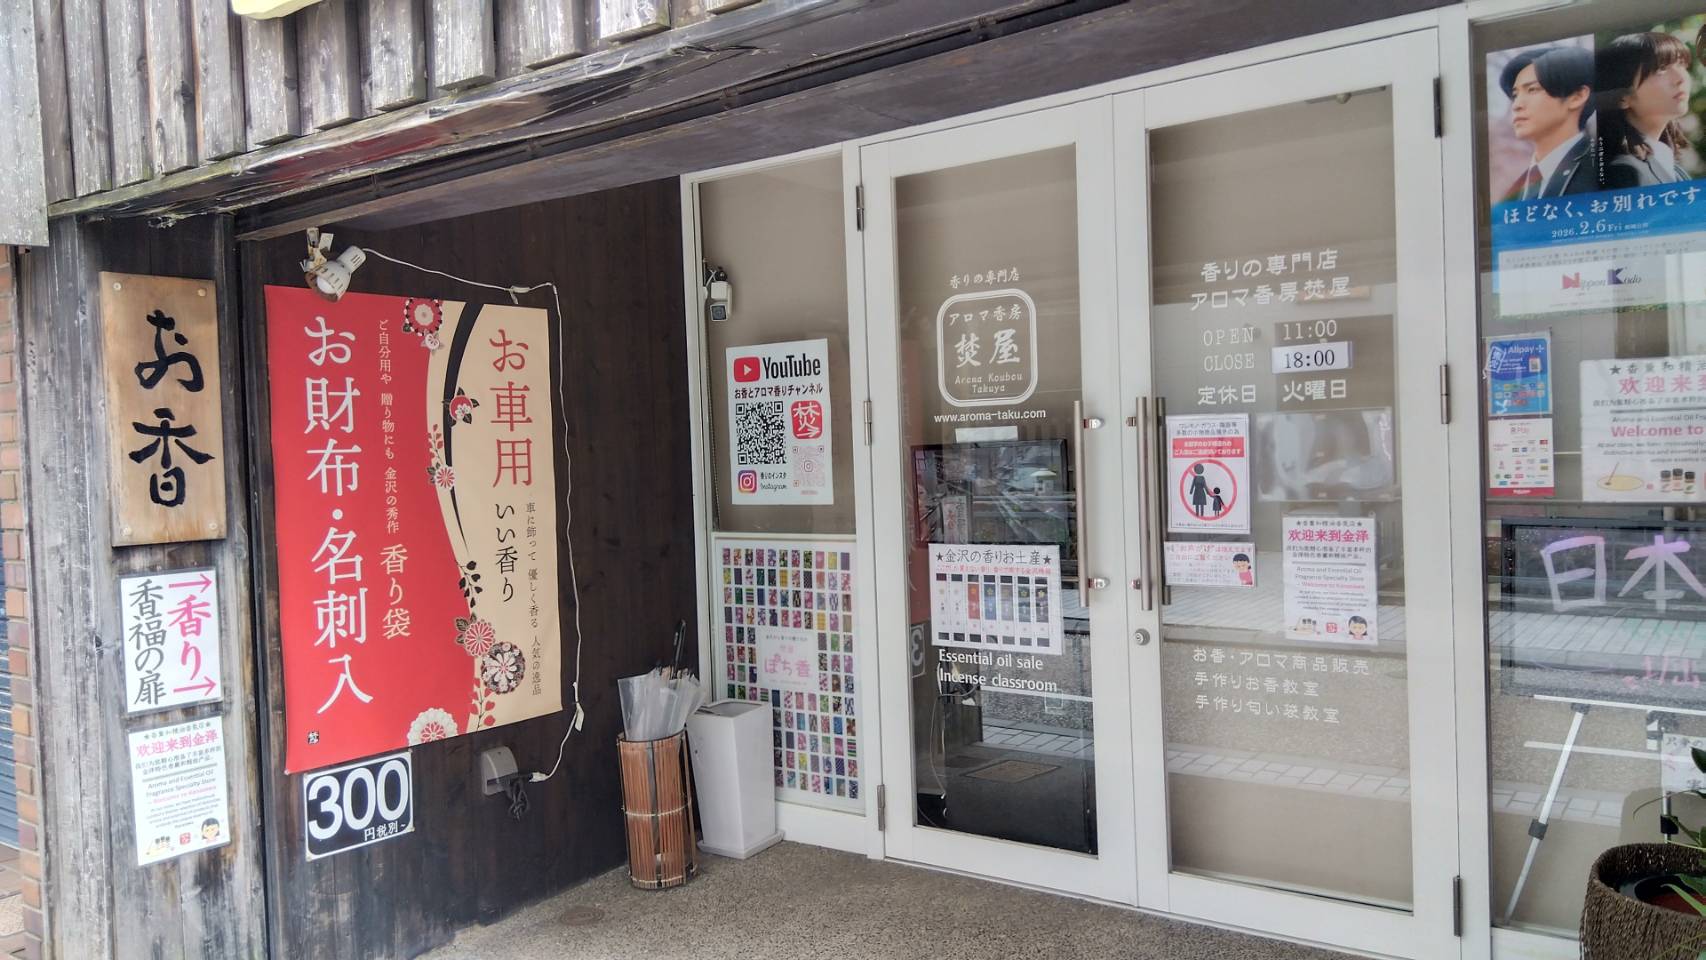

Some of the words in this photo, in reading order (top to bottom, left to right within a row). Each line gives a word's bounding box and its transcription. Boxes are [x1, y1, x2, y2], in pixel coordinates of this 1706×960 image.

[1503, 186, 1701, 225] ほどなく、お別れです
[949, 267, 1020, 289] 香りの専門店
[1201, 248, 1338, 283] 香りの専門店
[1203, 326, 1255, 346] OPEN
[1283, 320, 1337, 341] 11:00
[762, 353, 821, 379] YouTube
[1203, 353, 1255, 372] CLOSE
[1284, 349, 1335, 369] 18:00
[1198, 384, 1256, 405] 定休日
[1282, 379, 1346, 402] 火曜日
[128, 309, 215, 507] お香
[489, 329, 533, 487] お車用
[934, 409, 1046, 423] www.aroma-taku.com
[1611, 425, 1682, 438] Welcome
[1687, 425, 1704, 435] to
[304, 316, 374, 714] お財布・名刺入
[495, 502, 518, 603] いい香り
[945, 548, 1041, 565] 金沢の香りお土産
[380, 543, 411, 640] 香り袋
[128, 579, 167, 705] 香福の扉
[167, 594, 211, 681] 香り
[938, 649, 993, 666] Essential
[997, 655, 1012, 668] oil
[1016, 657, 1043, 670] sale
[1193, 647, 1369, 676] お香・アロマ商品販売
[940, 667, 986, 686] Incense
[992, 674, 1057, 692] classroom
[1195, 672, 1320, 697] 手作りお香教室
[308, 760, 409, 840] 300
